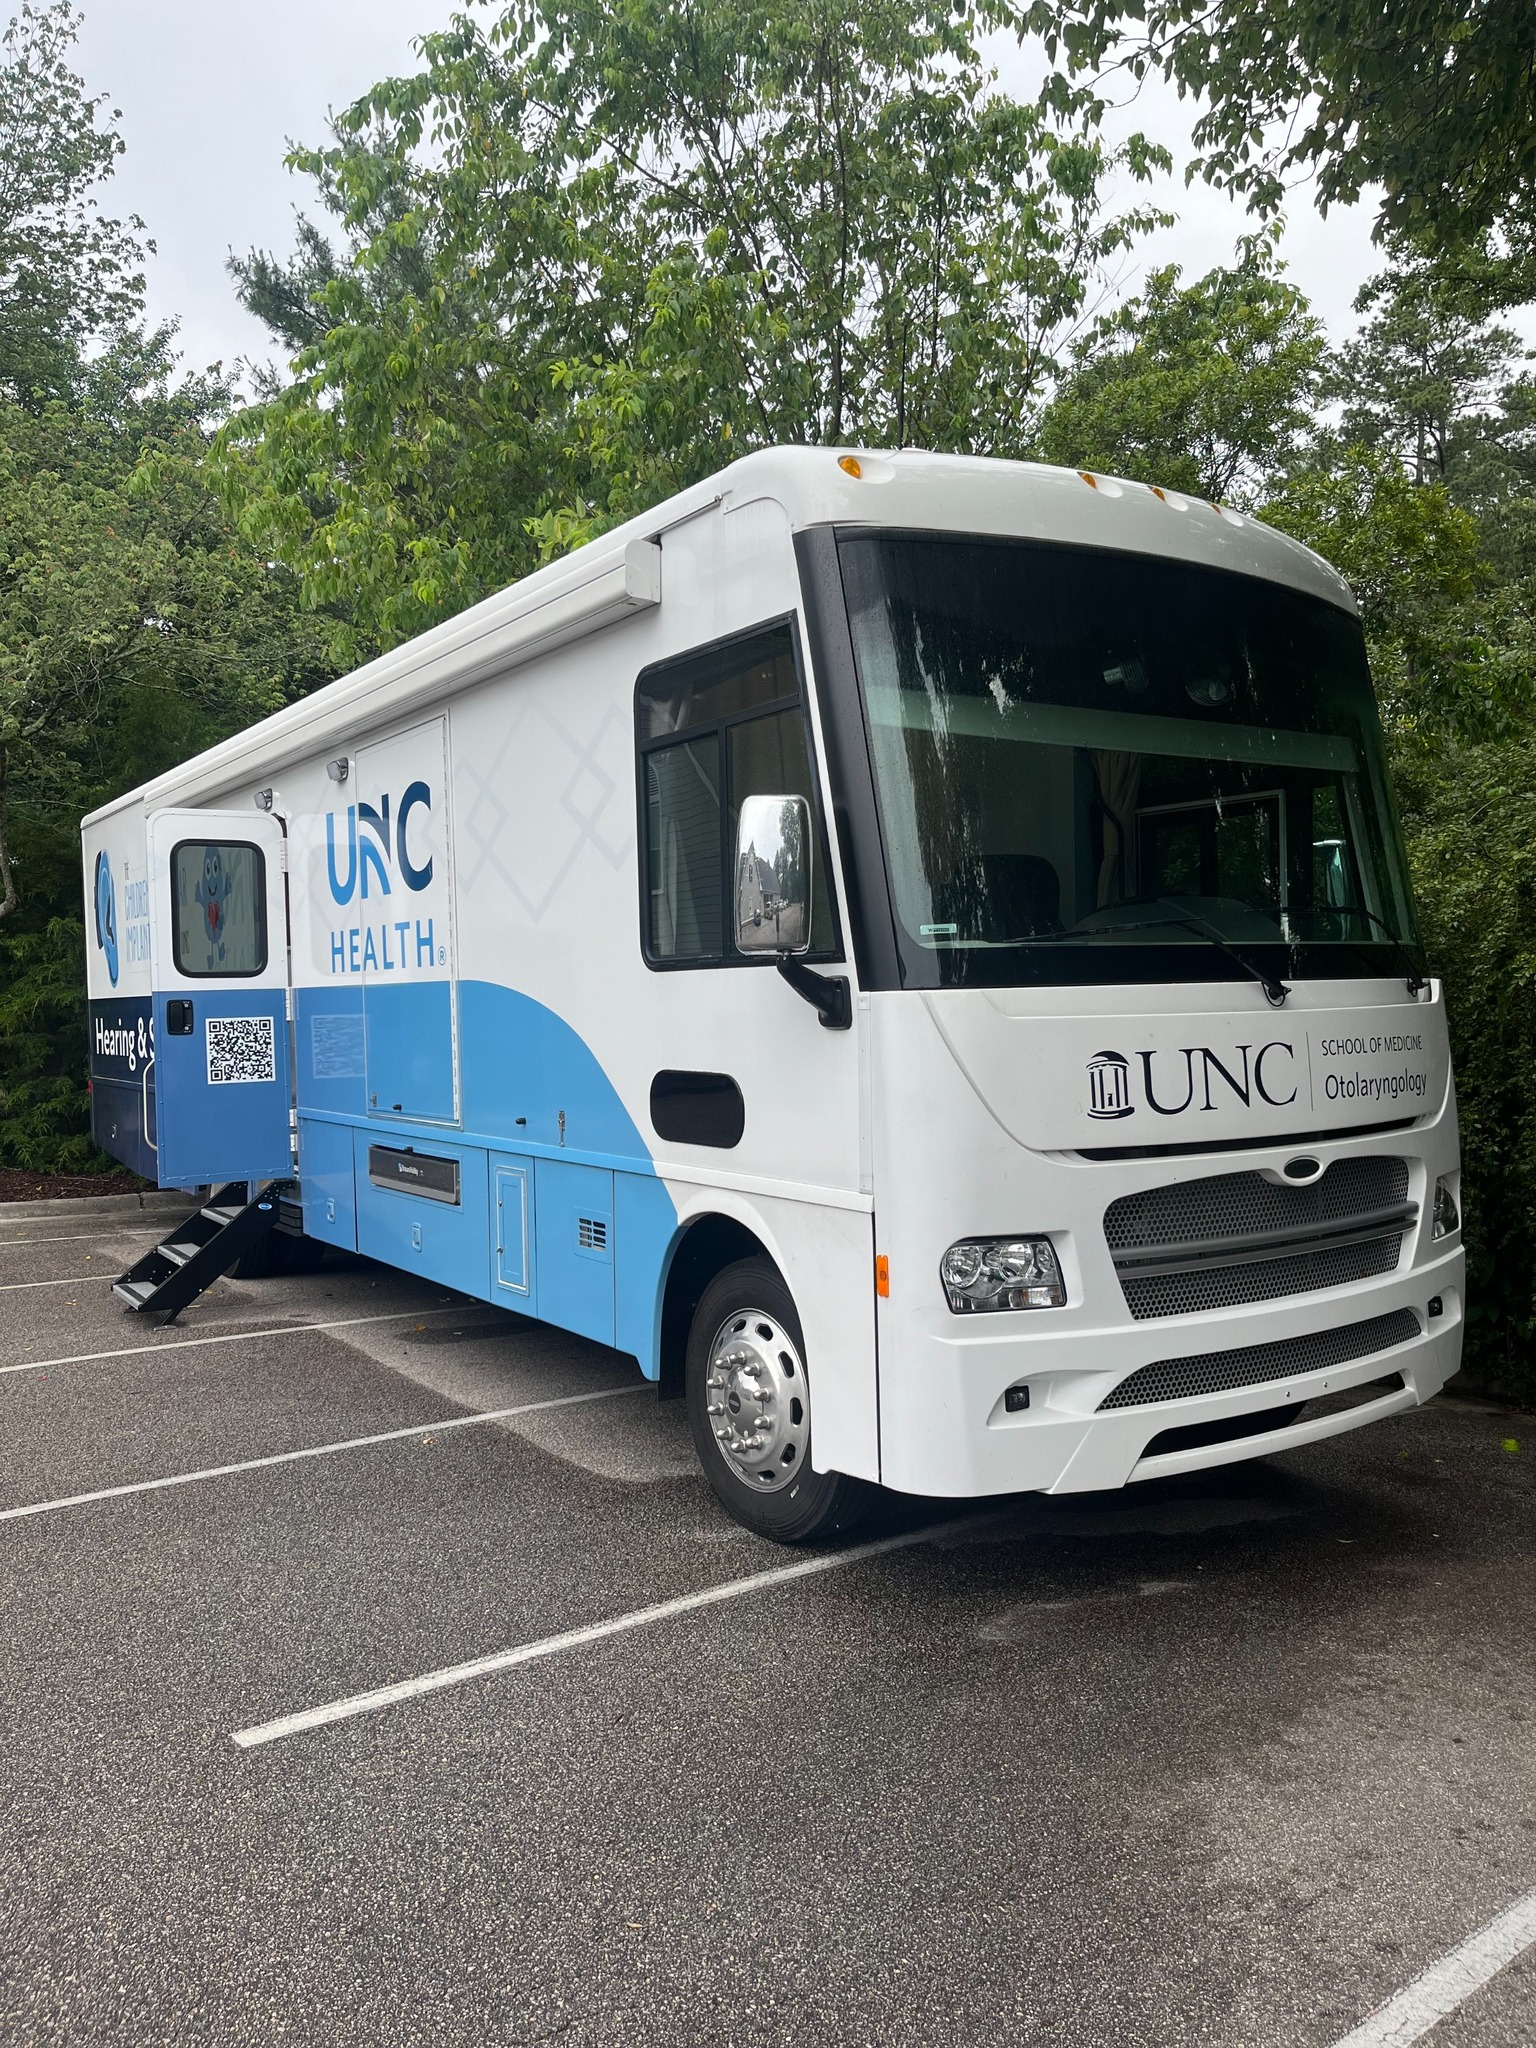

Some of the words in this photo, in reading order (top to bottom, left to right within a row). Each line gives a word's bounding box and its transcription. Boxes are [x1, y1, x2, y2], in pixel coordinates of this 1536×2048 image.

[326, 781, 433, 906] UNC
[95, 1017, 136, 1071] Hearing
[137, 1016, 148, 1058] &
[1321, 1038, 1367, 1057] SCHOOL
[1369, 1036, 1382, 1053] OF
[1383, 1034, 1423, 1052] MEDICINE
[1135, 1042, 1297, 1115] UNC
[1324, 1068, 1427, 1101] Otolaryngology
